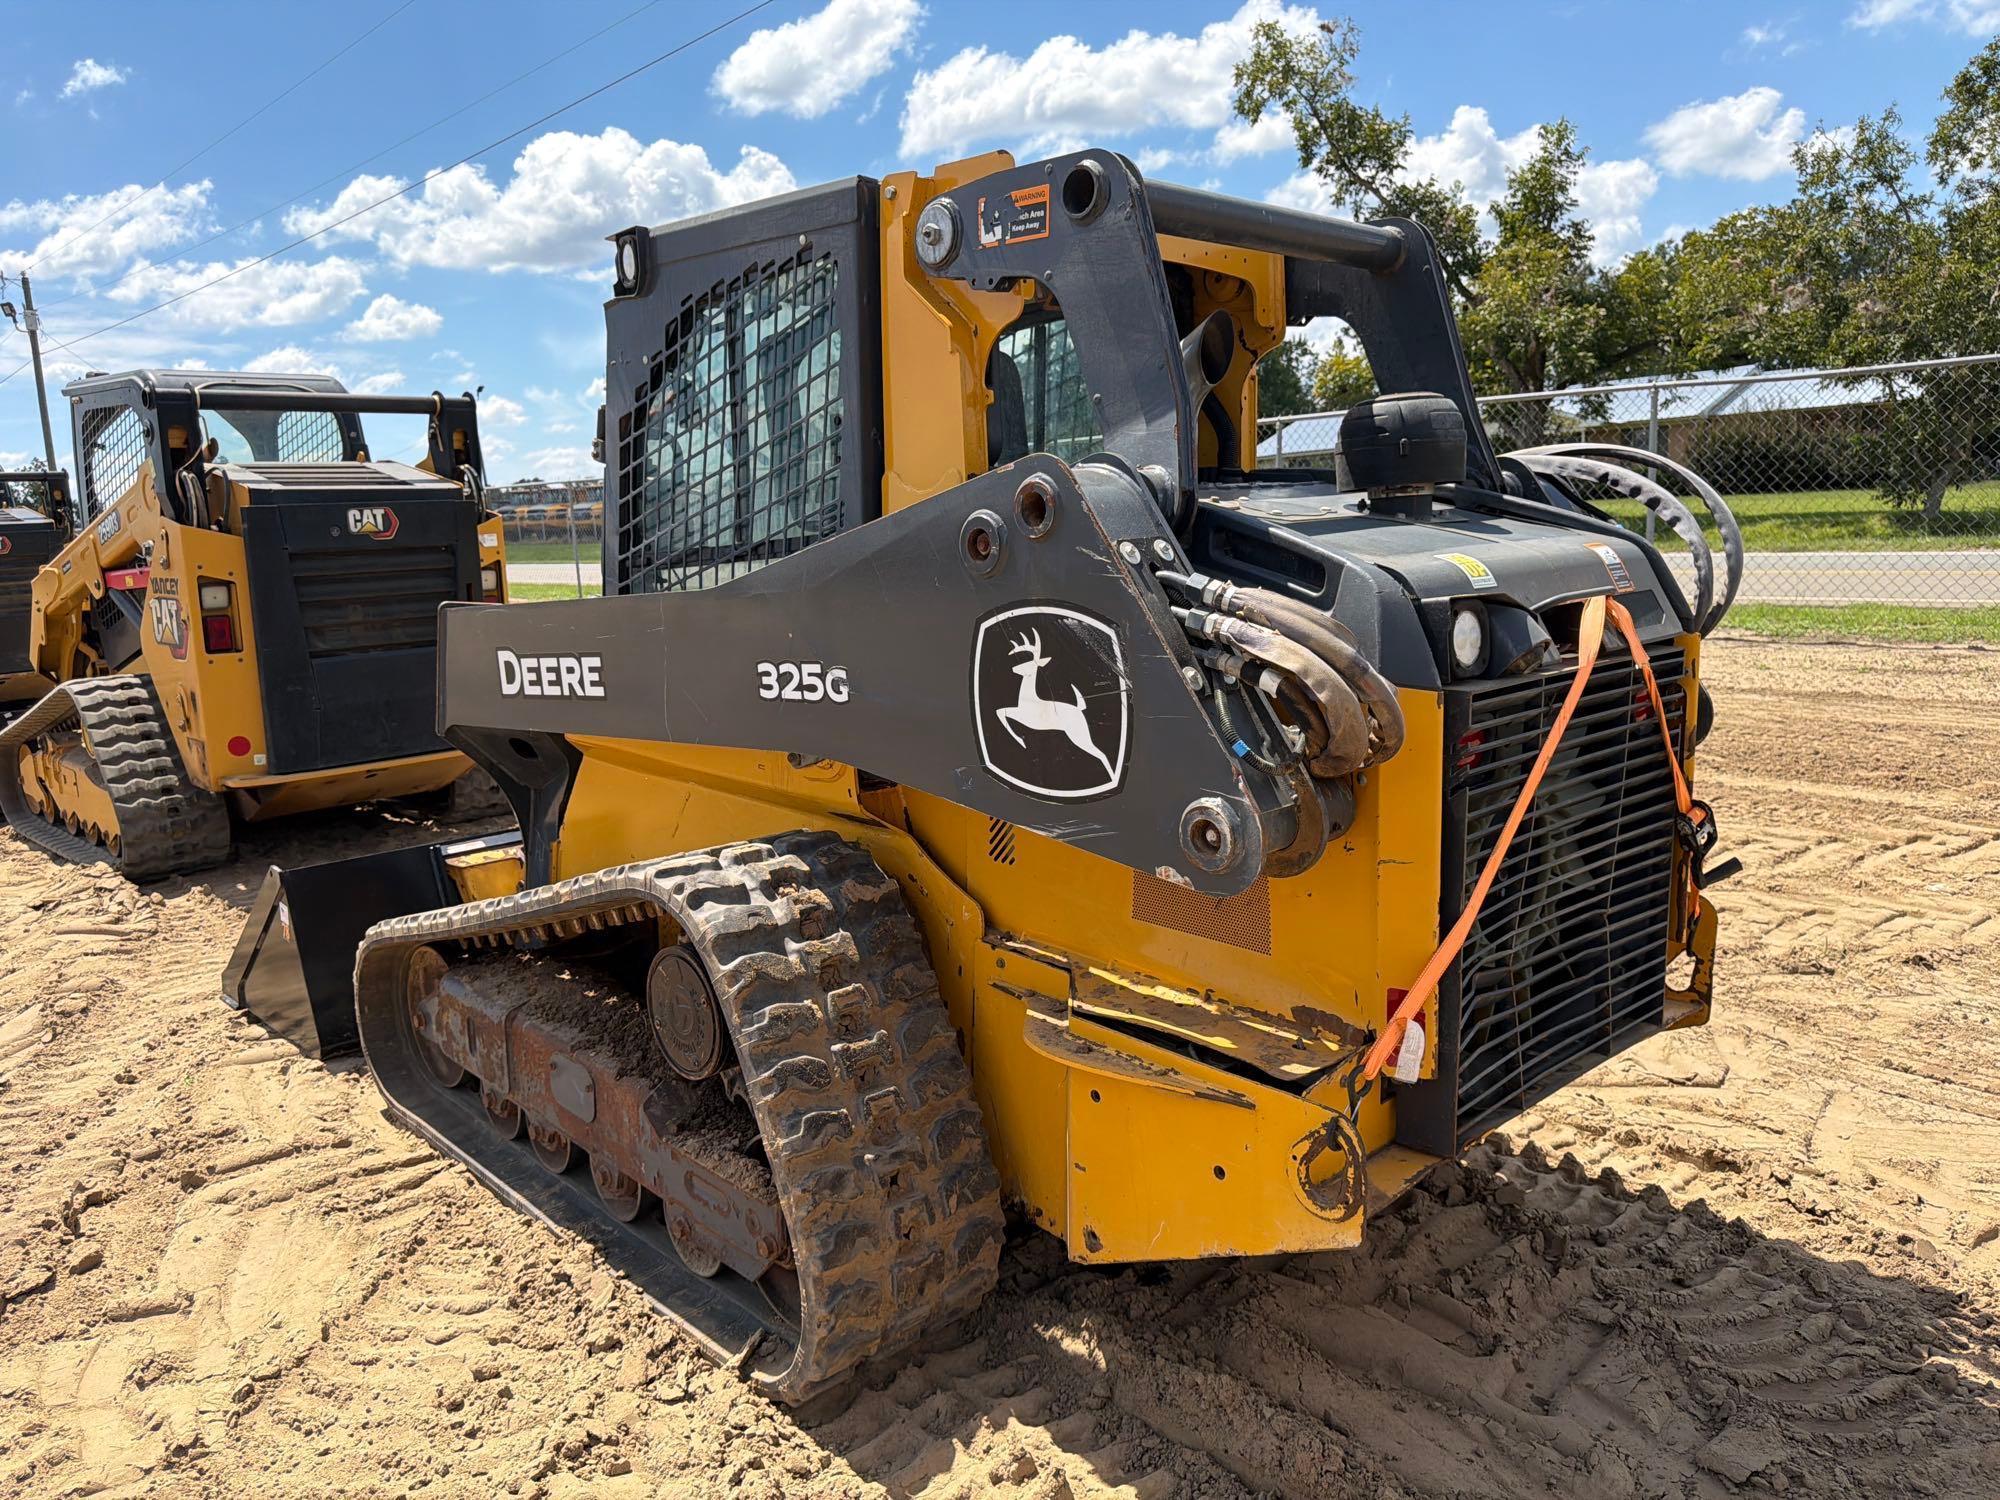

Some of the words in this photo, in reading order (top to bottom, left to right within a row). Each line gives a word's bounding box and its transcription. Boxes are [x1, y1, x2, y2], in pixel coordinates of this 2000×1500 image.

[1018, 190, 1046, 202] WARNING
[1030, 210, 1045, 218] Area
[1011, 224, 1025, 232] Keep
[1025, 222, 1040, 230] Away
[348, 508, 385, 533] CAT
[149, 598, 179, 645] CAT
[757, 662, 849, 702] 325G
